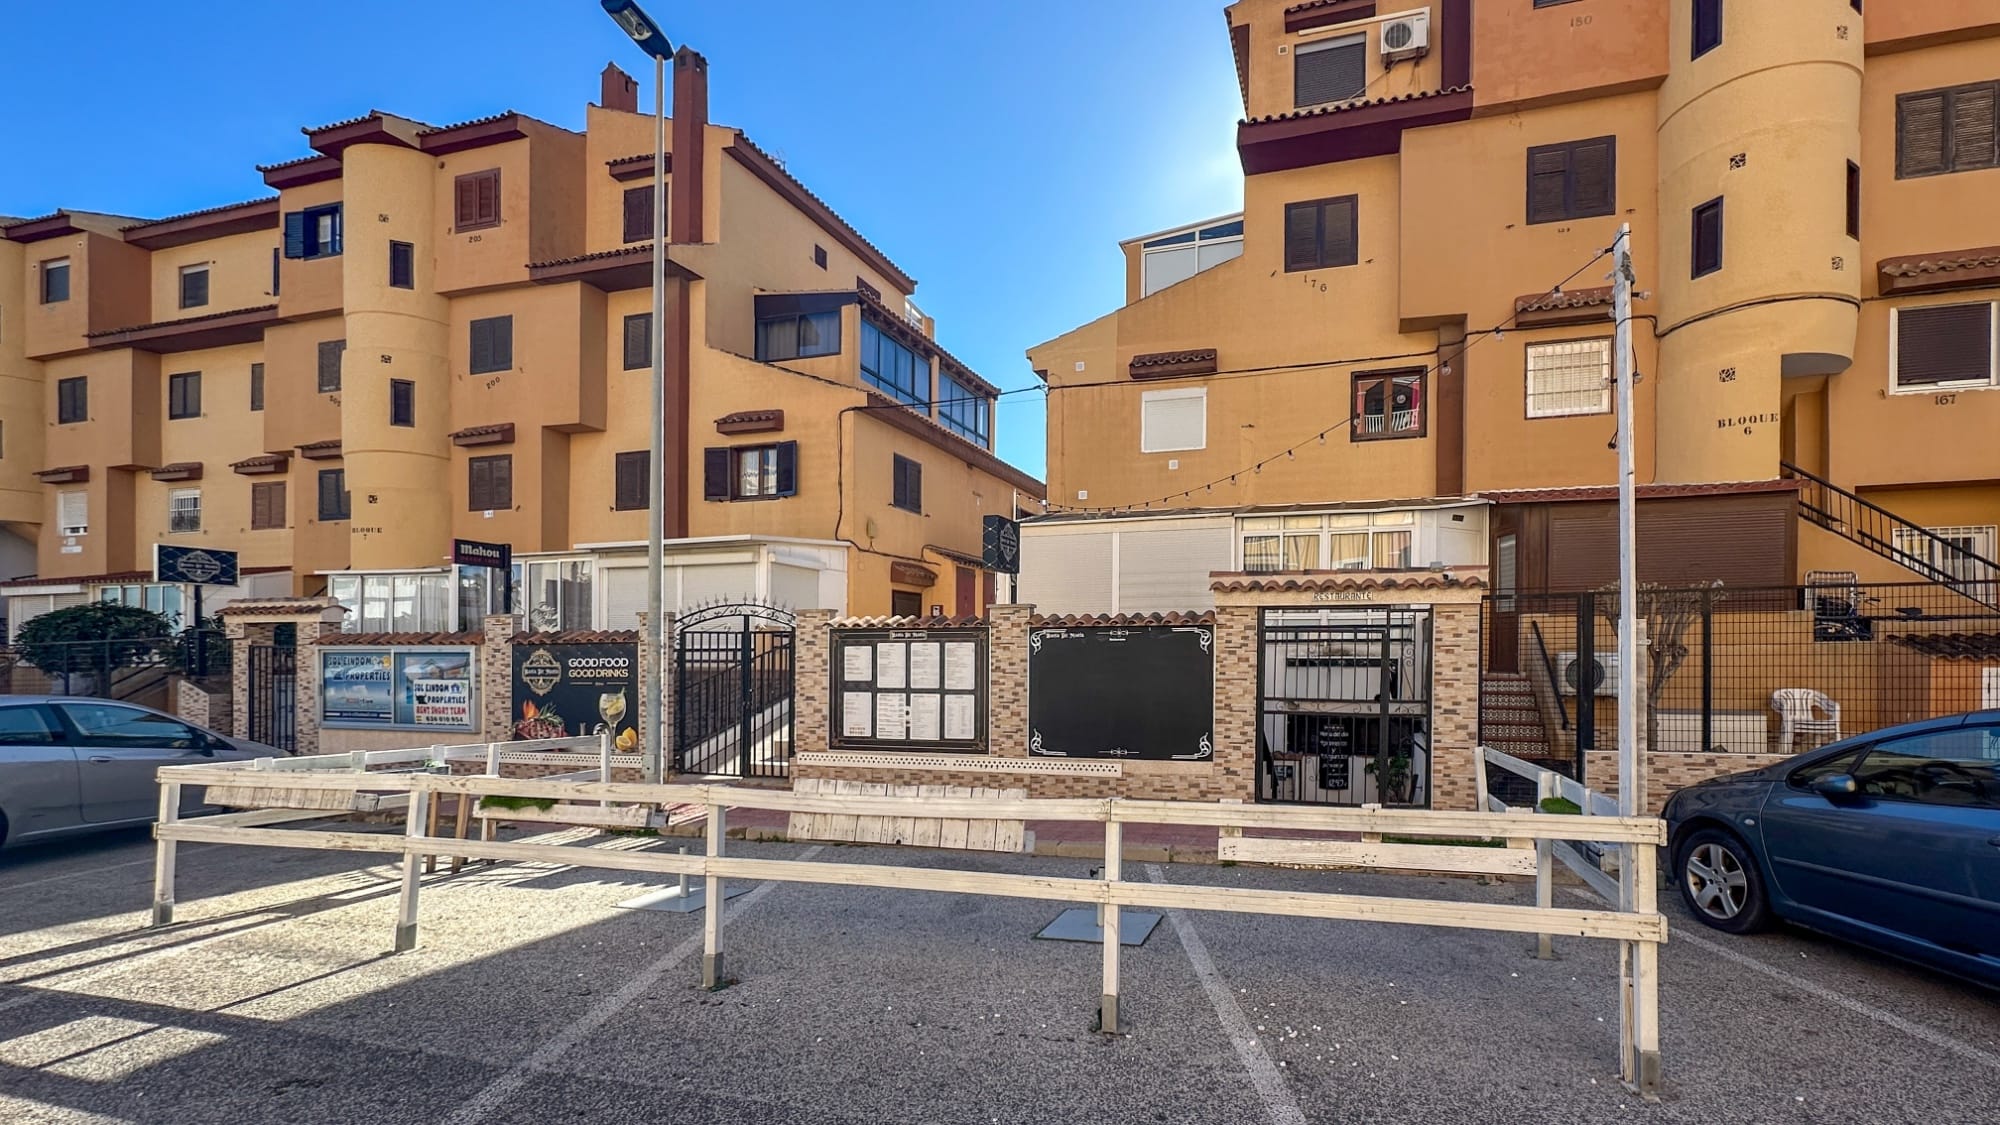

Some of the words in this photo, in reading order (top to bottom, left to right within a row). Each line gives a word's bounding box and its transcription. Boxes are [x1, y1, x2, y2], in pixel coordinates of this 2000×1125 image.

[1303, 274, 1328, 293] 176
[1935, 394, 1956, 405] 167
[1718, 413, 1778, 428] BLOQUE
[1744, 426, 1752, 435] 6
[460, 543, 500, 558] Mahou
[1312, 591, 1374, 601] RESTAURANTE
[568, 658, 599, 668] GOOD
[600, 657, 630, 668] FOOD
[568, 669, 596, 678] GOOD
[596, 669, 629, 678] DRINKS
